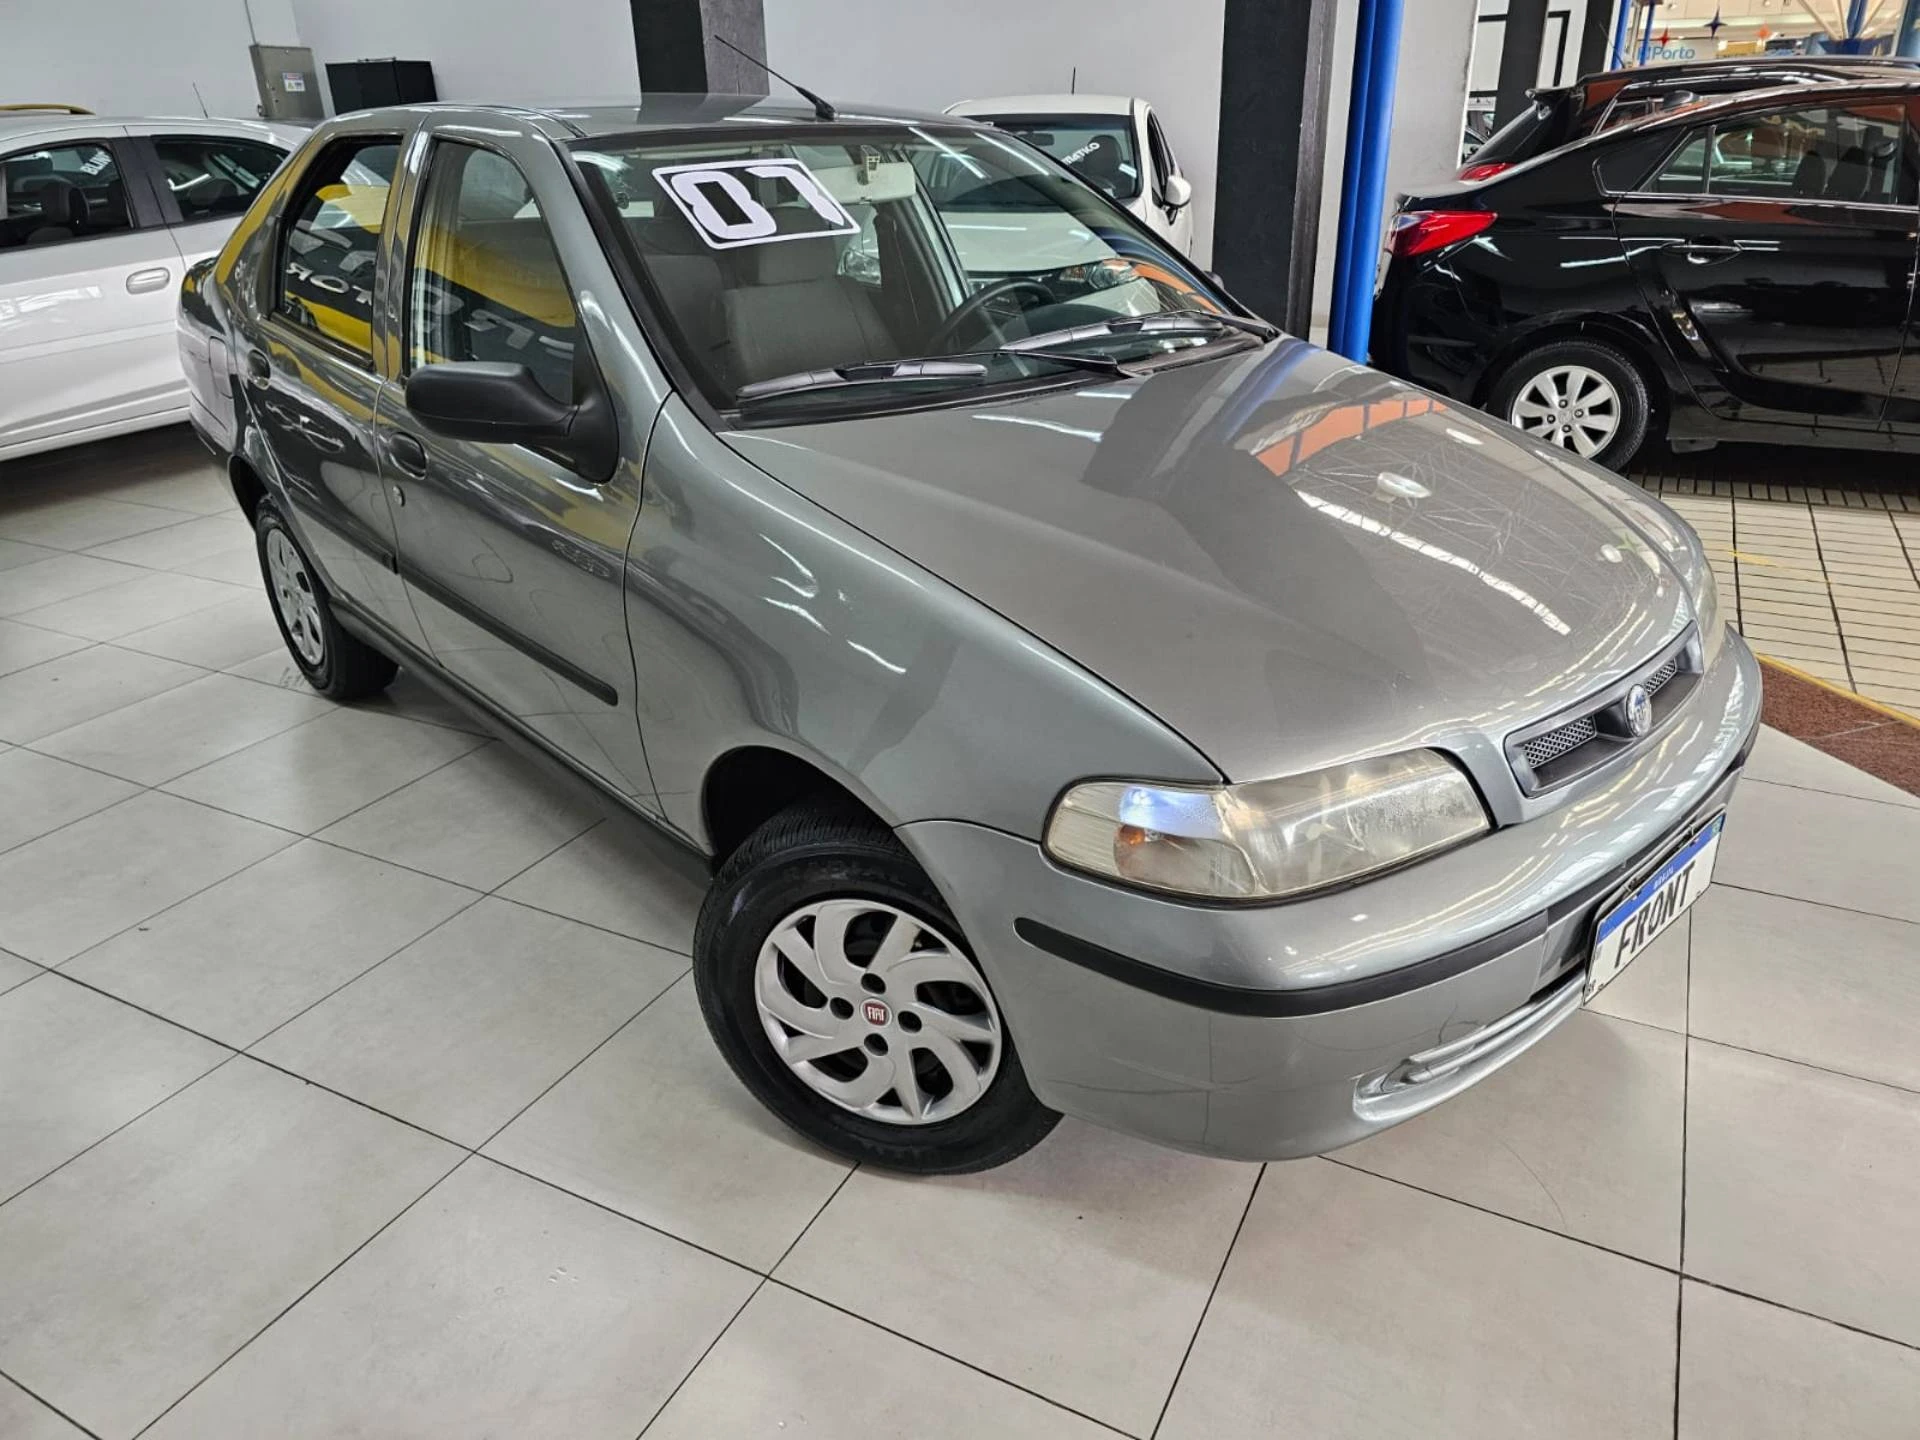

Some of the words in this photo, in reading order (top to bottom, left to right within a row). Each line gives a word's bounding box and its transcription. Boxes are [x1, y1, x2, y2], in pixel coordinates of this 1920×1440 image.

[1652, 46, 1696, 60] Porto
[1615, 860, 1696, 968] FRONT
[867, 1006, 885, 1022] FIAT
